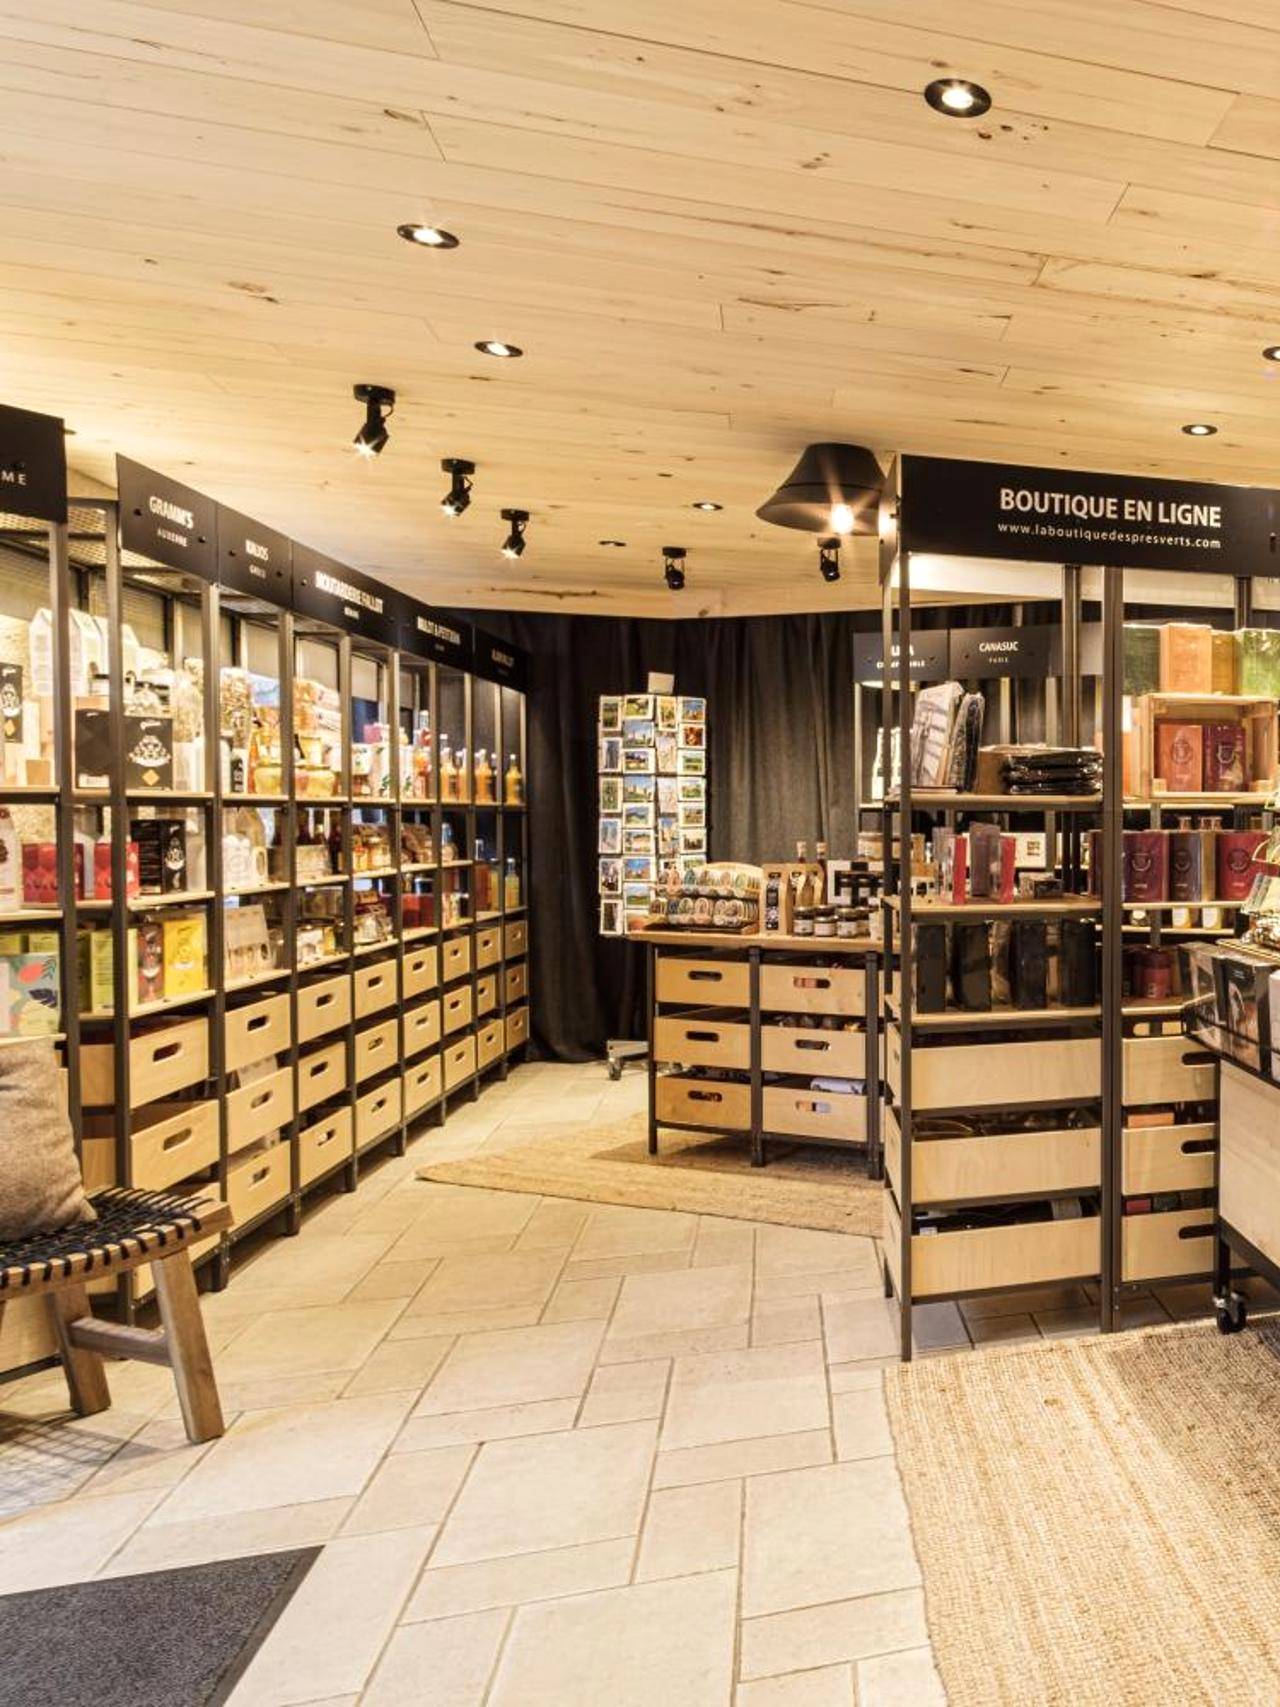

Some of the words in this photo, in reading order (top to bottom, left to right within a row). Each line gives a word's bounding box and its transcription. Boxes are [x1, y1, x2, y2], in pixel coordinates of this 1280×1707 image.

[1000, 488, 1118, 520] BOUTIQUE
[1124, 499, 1153, 522] EN
[1158, 502, 1222, 528] LIGNE
[997, 522, 1222, 549] www.laboutiquedespresverts.com
[978, 641, 1019, 653] CANASUC
